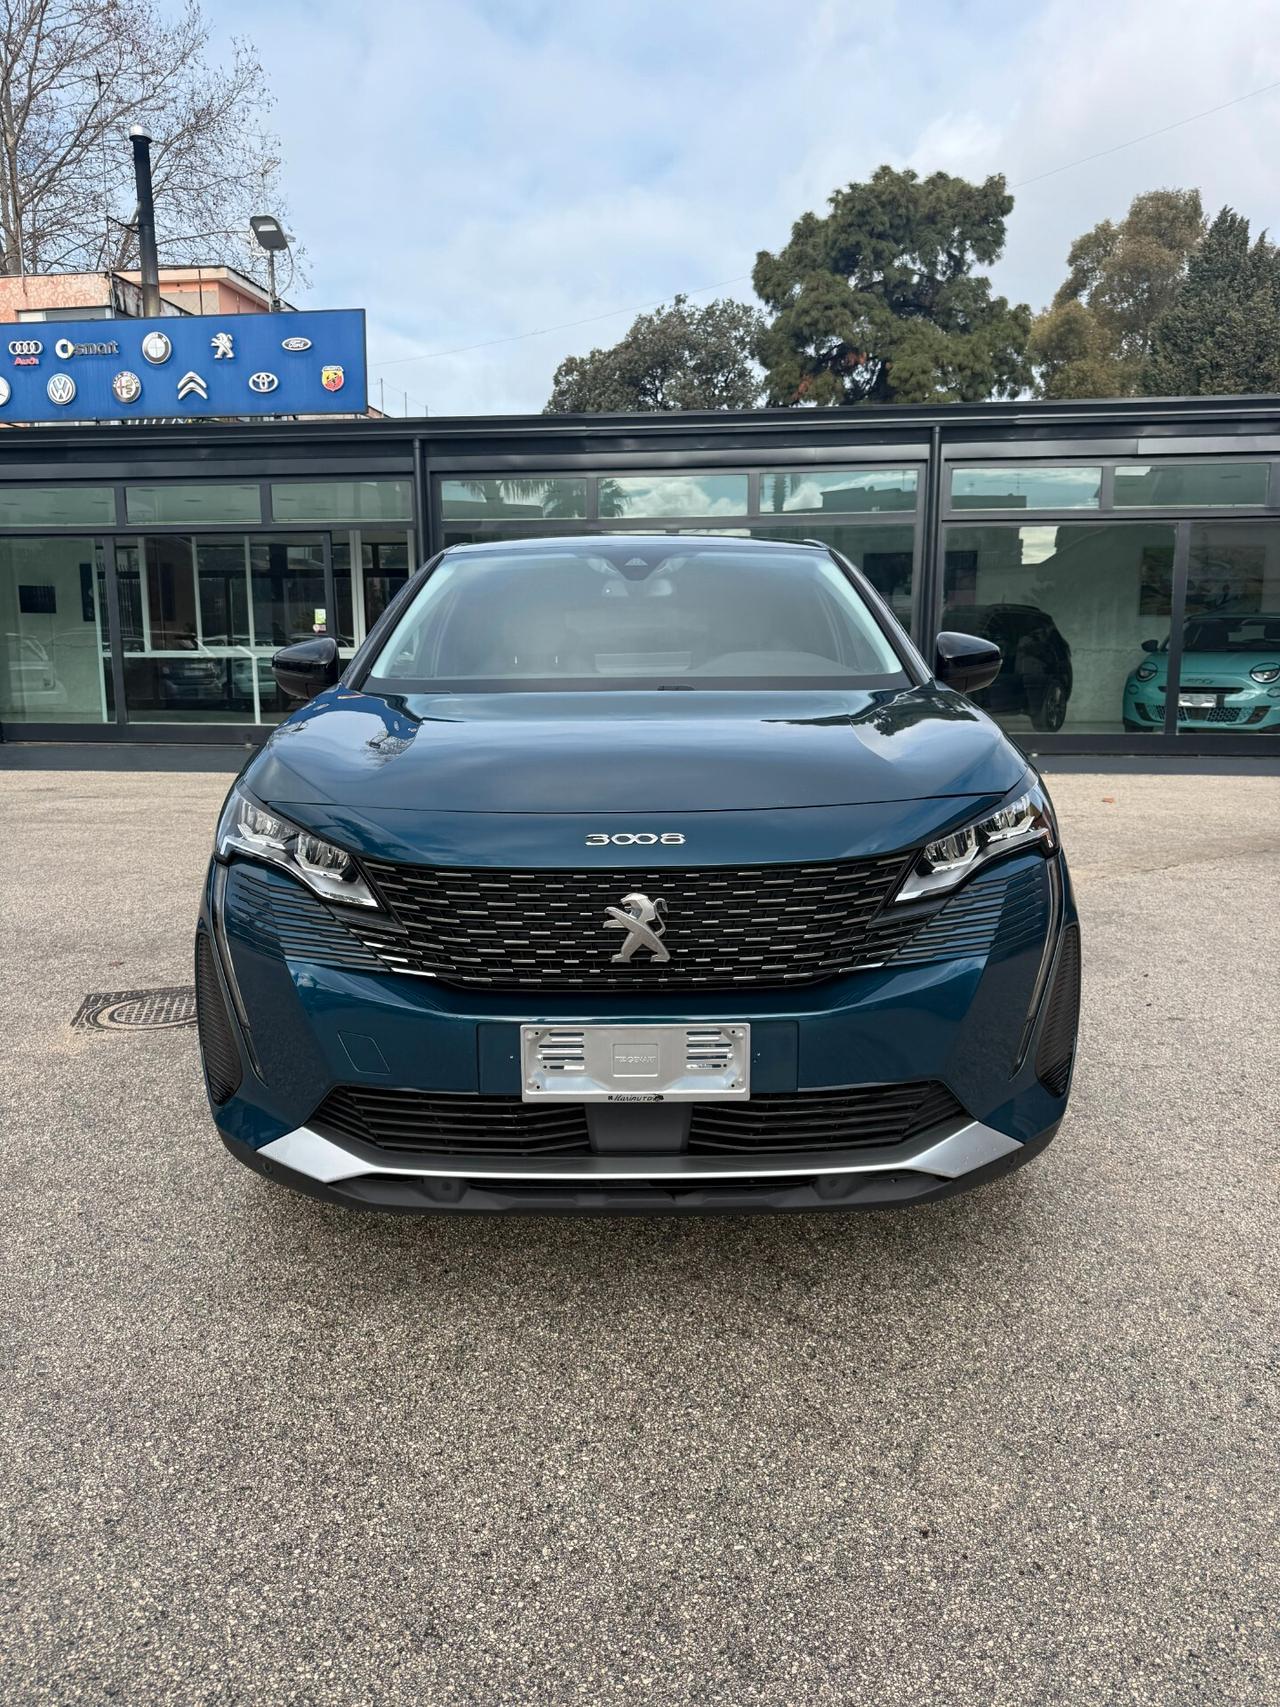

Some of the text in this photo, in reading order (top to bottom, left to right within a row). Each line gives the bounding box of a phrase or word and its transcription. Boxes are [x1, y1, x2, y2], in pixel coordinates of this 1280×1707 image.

[74, 339, 119, 355] smart
[14, 356, 39, 366] Audi
[584, 832, 687, 846] 3008
